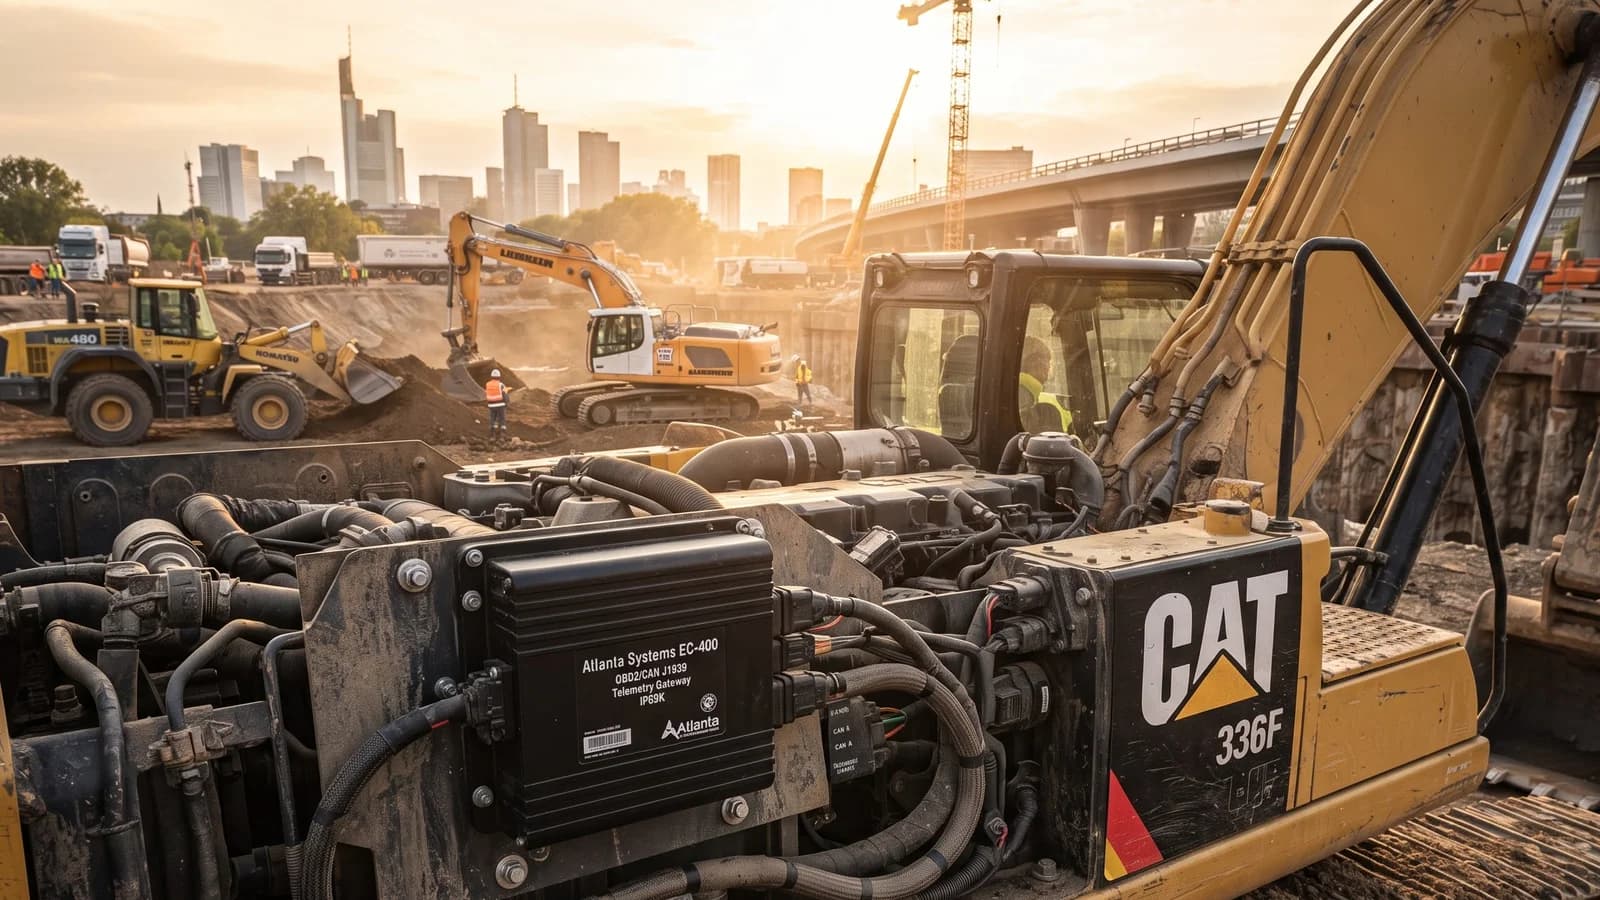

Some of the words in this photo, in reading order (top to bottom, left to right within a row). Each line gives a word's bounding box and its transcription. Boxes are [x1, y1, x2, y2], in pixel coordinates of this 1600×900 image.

[582, 656, 624, 674] Atlanta
[628, 648, 676, 667] Systems
[679, 638, 719, 656] EC-400
[1141, 569, 1289, 727] CAT
[615, 667, 660, 685] OBD2/CAN
[662, 662, 688, 676] J1939
[612, 683, 654, 698] Telemetry
[656, 676, 692, 690] Gateway
[640, 693, 666, 706] IP69K
[677, 716, 719, 734] Atlanta
[1216, 708, 1284, 766] 336F
